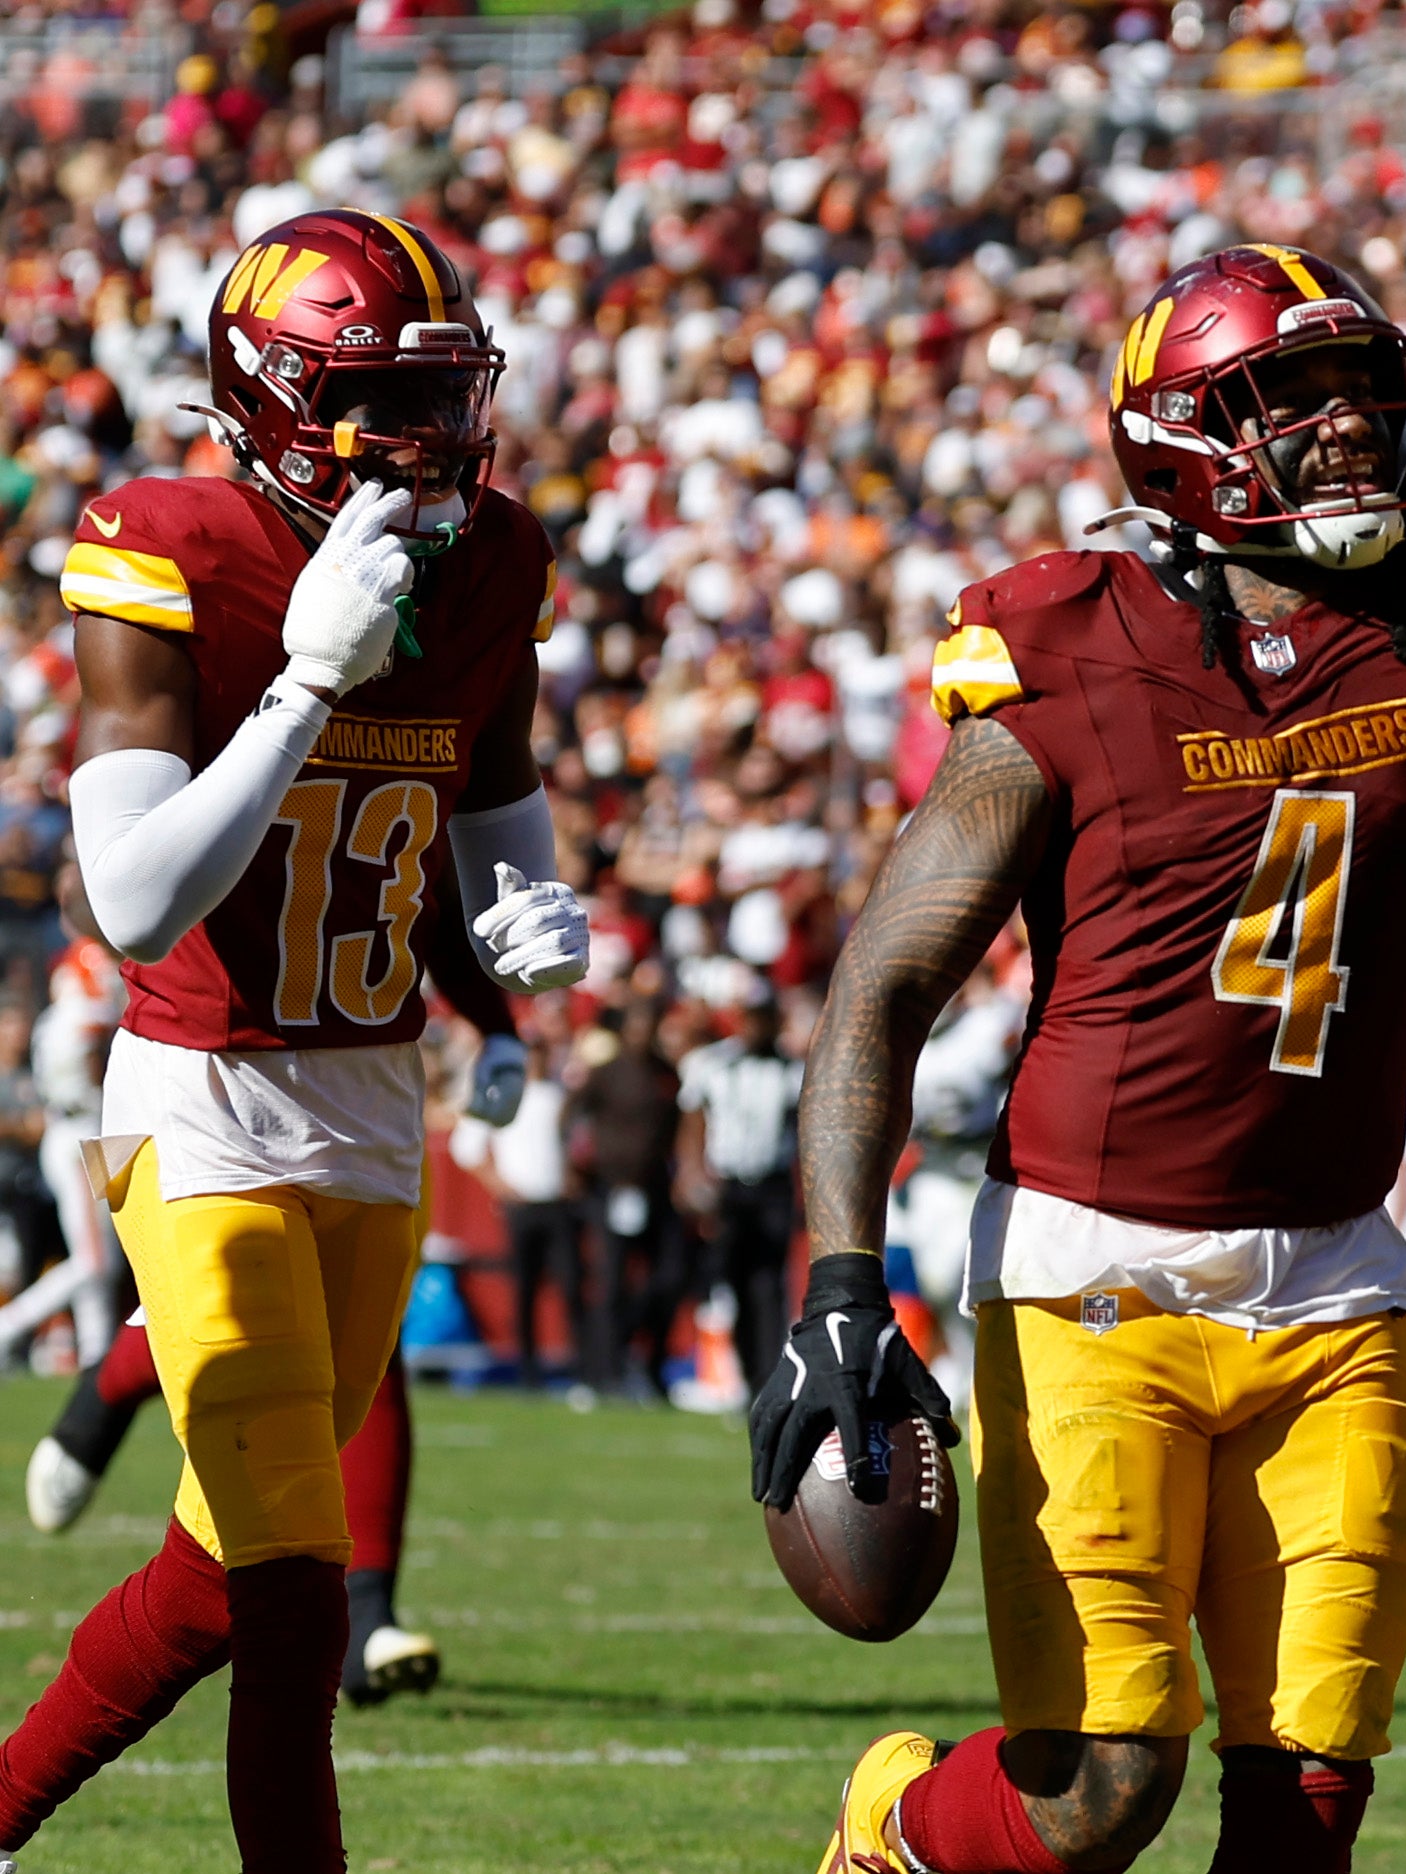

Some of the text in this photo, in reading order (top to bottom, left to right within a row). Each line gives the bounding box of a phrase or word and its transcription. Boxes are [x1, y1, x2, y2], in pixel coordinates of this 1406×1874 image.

[335, 337, 382, 346] OAKLEY
[311, 722, 456, 762] MMANDERS
[271, 779, 438, 1026] 13
[1210, 789, 1355, 1077] 4
